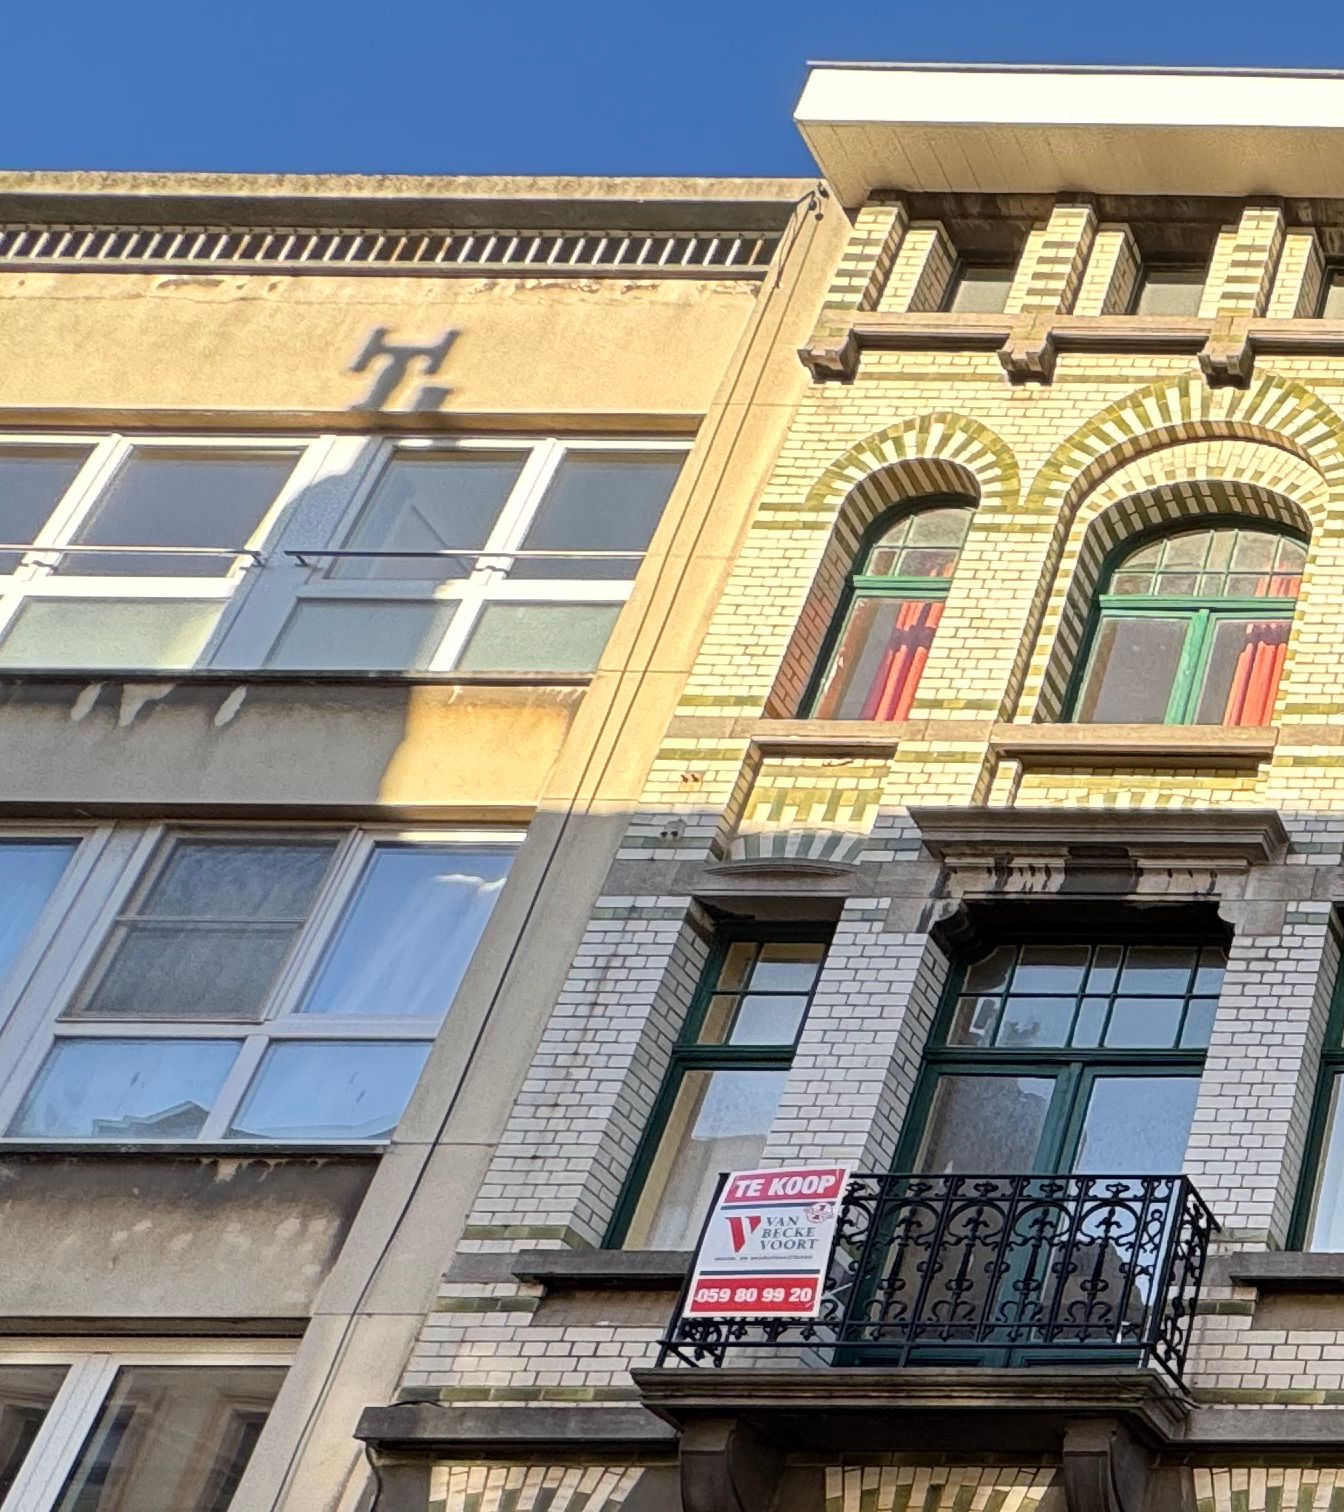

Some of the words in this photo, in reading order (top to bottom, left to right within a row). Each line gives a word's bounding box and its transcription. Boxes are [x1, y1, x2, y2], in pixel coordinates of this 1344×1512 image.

[735, 1178, 765, 1198] TE
[768, 1175, 836, 1196] KOOP
[765, 1216, 800, 1227] VAN
[761, 1227, 816, 1238] BECKE
[760, 1238, 819, 1250] VOORT
[695, 1288, 732, 1303] 059
[734, 1288, 758, 1302] 80
[761, 1287, 786, 1302] 99
[789, 1287, 813, 1302] 20
